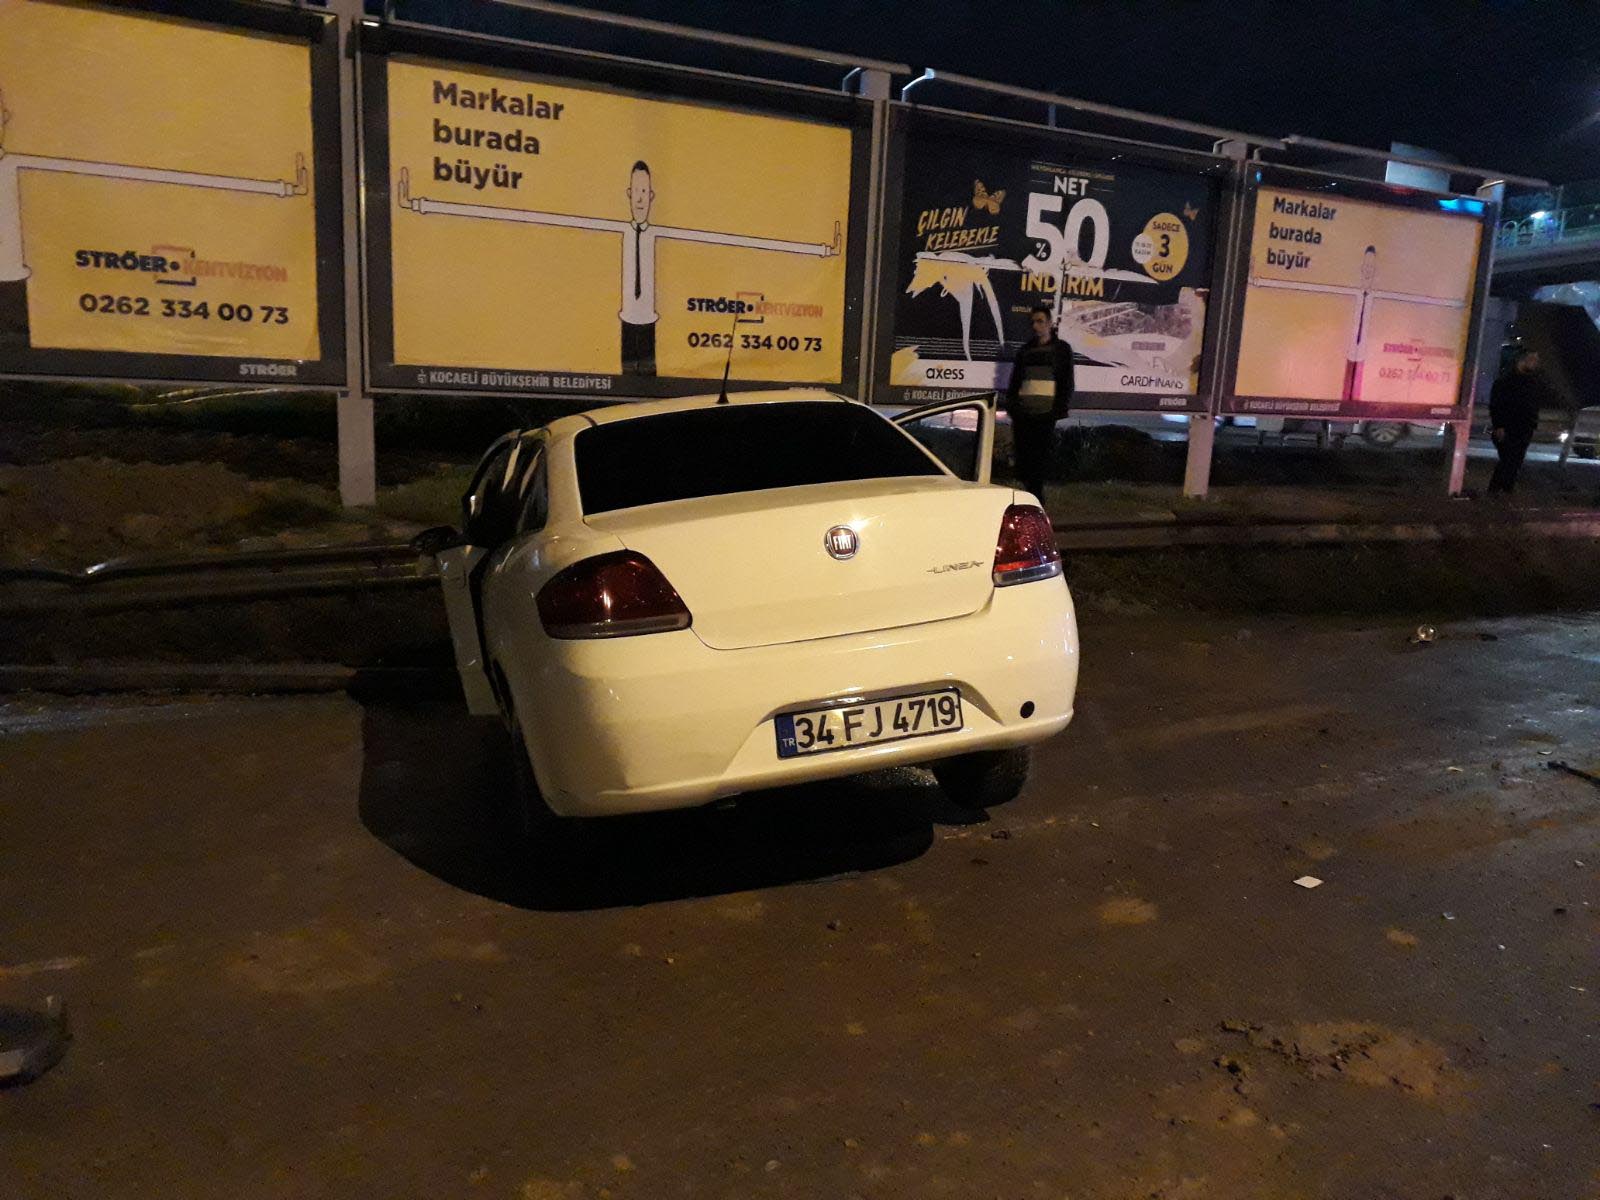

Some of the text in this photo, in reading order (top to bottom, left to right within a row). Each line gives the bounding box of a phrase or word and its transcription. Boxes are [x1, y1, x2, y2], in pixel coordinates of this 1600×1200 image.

[433, 80, 564, 120] Markalar
[433, 118, 540, 155] burada
[433, 156, 523, 190] büyür
[1053, 175, 1089, 196] NET
[1273, 196, 1337, 220] Markalar
[917, 206, 969, 237] ÇILGIN
[1022, 192, 1109, 268] 50
[1152, 221, 1181, 232] SADECE
[926, 226, 999, 250] KELEBEKLE
[1269, 222, 1323, 244] burada
[1036, 243, 1046, 258] %
[1159, 233, 1170, 257] 3
[75, 250, 168, 273] STRÖER
[1266, 248, 1311, 270] büyür
[79, 293, 289, 325] 0262 334 00 73
[687, 297, 745, 314] STRÖER
[688, 332, 822, 352] 0262 334 00 73
[429, 371, 478, 385] KOCAELİ
[481, 373, 549, 388] BÜYÜKŞEHİR
[926, 367, 965, 380] axess
[832, 535, 852, 551] FIAT
[926, 560, 984, 574] LINEA
[782, 738, 795, 748] TR
[795, 714, 835, 748] 34
[892, 695, 957, 733] 4719
